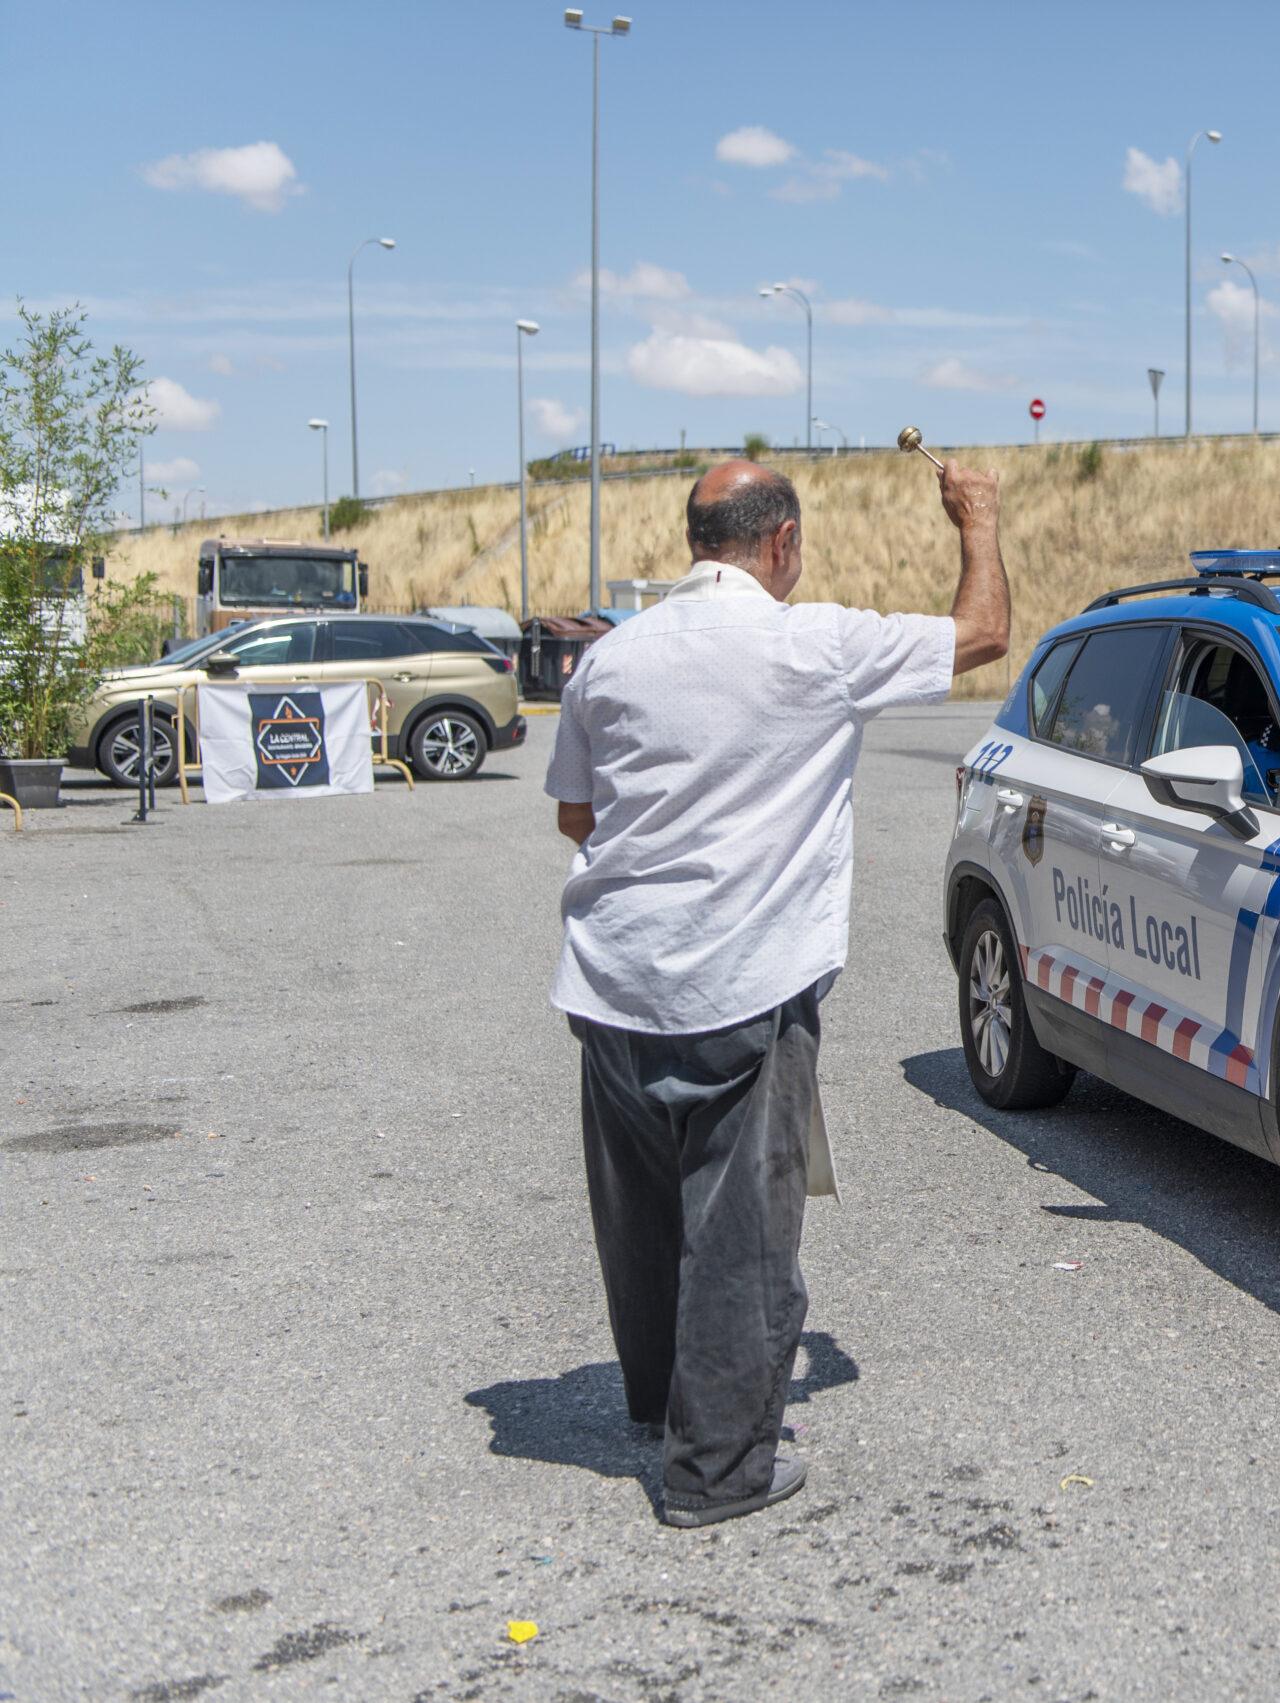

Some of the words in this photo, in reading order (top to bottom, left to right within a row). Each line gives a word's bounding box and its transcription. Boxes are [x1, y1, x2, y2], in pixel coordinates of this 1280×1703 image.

[269, 733, 280, 744] LA
[970, 741, 1013, 786] 112
[1052, 867, 1125, 950] Policía
[1130, 895, 1201, 981] Local
